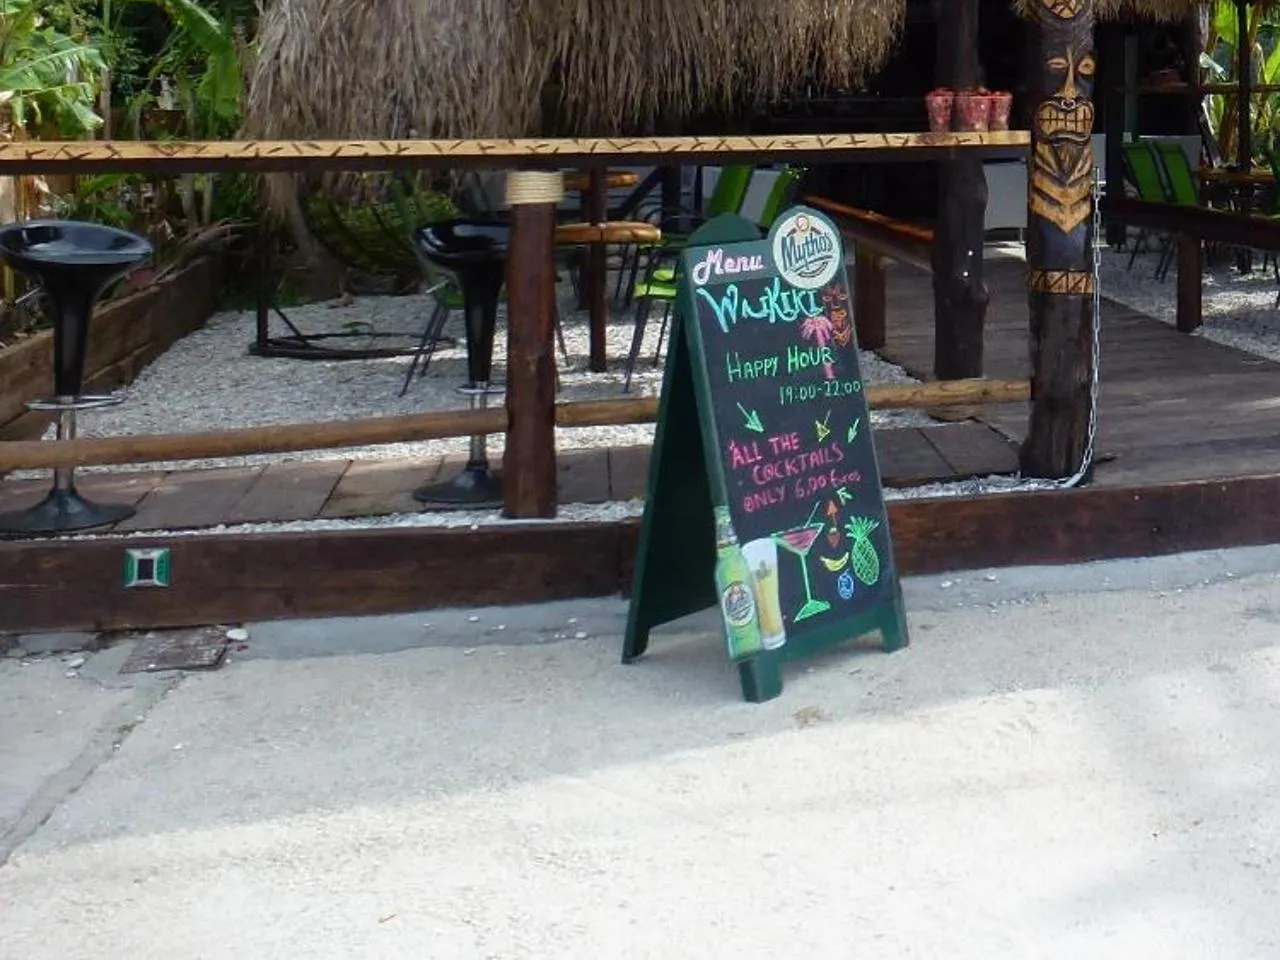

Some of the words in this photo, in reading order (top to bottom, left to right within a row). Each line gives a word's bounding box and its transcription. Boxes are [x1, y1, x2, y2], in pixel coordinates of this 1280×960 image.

[692, 247, 765, 286] Menu
[780, 231, 834, 272] Mythos
[726, 350, 779, 383] HAPPY
[787, 344, 836, 374] HOUR
[780, 380, 861, 406] 19:00-22:00
[729, 440, 762, 470] ALL
[768, 432, 800, 455] THE
[752, 442, 844, 485] COCKTAILS
[743, 485, 786, 513] ONLY
